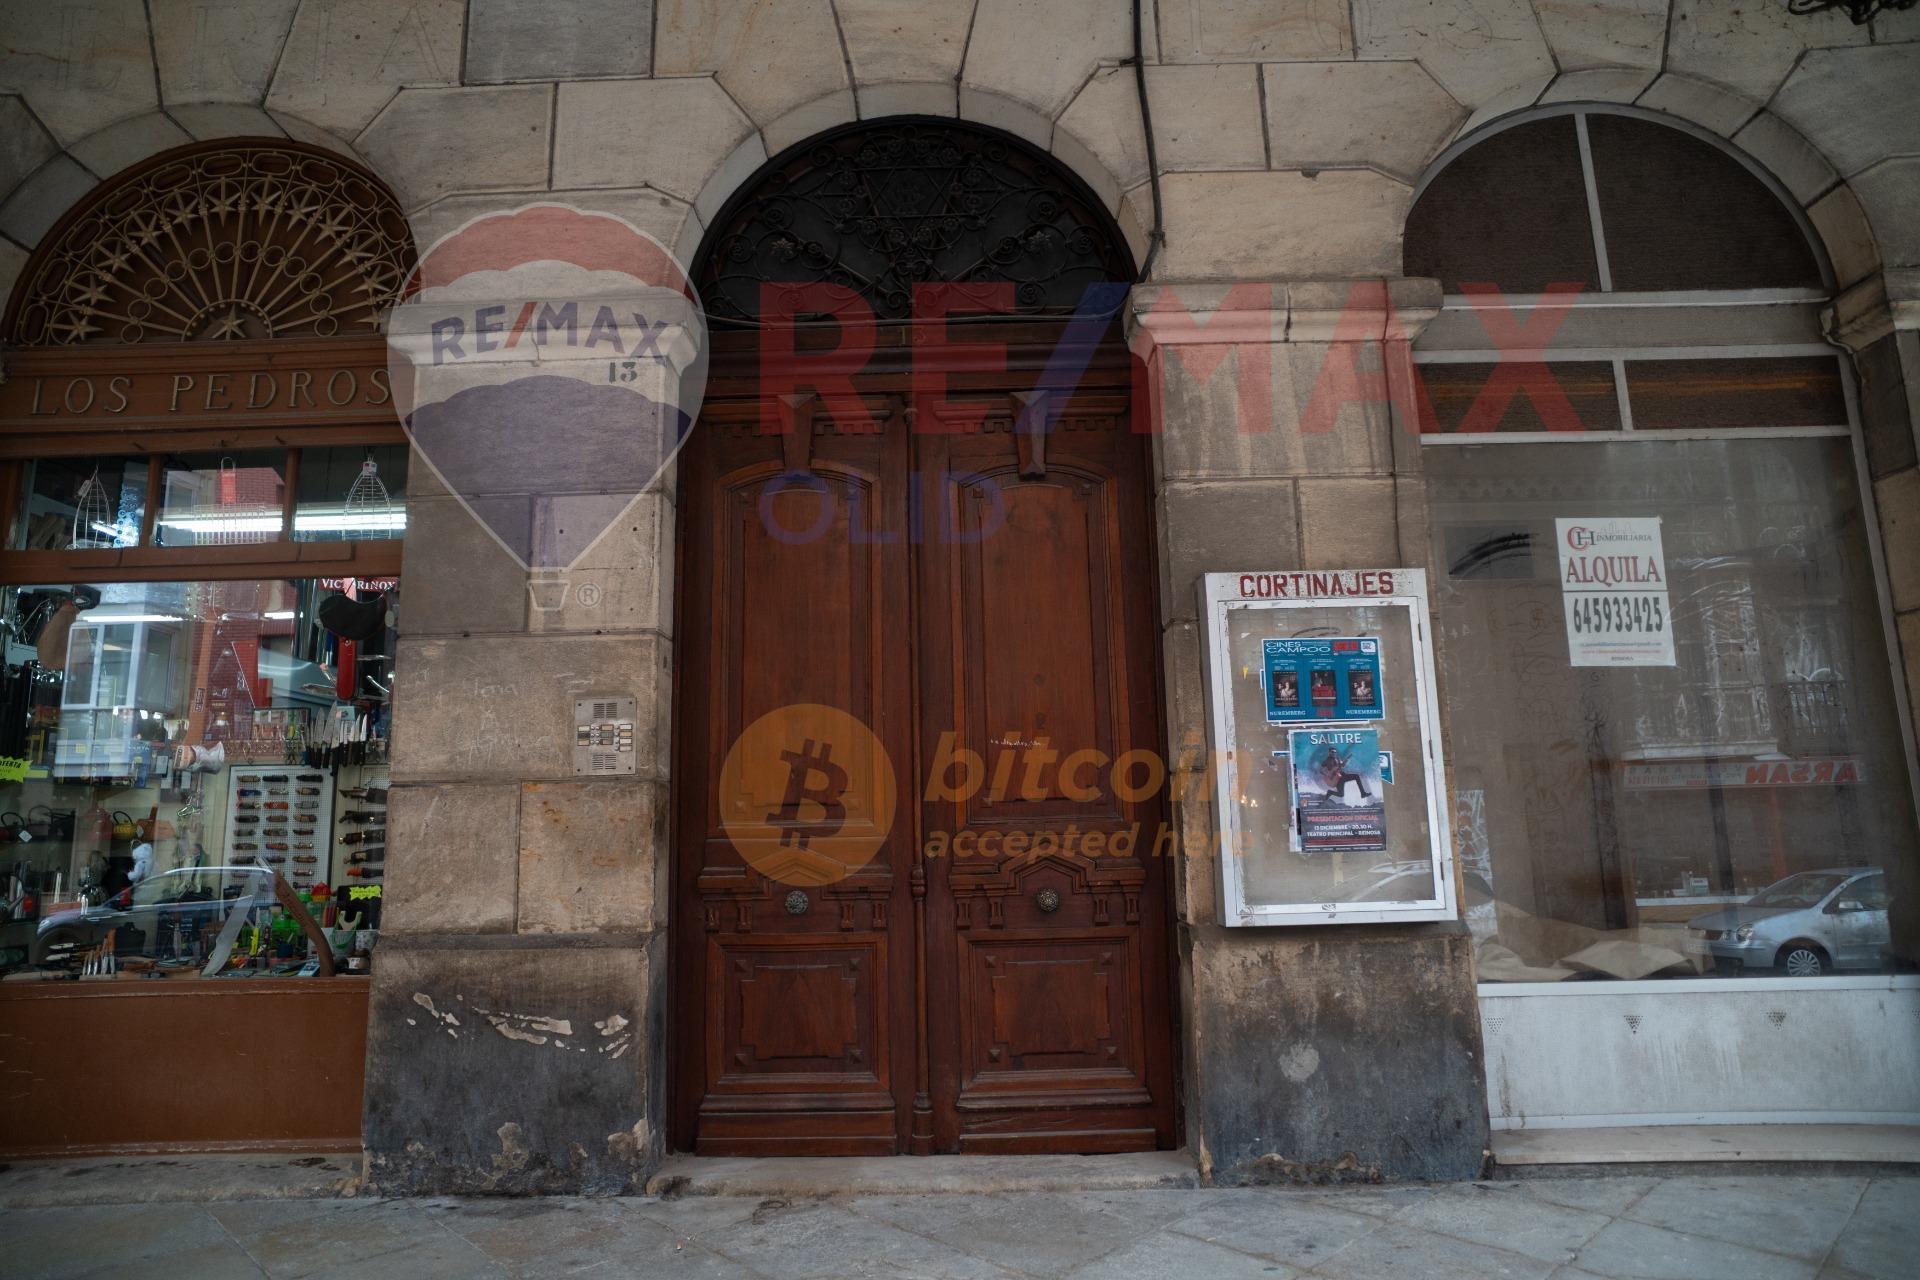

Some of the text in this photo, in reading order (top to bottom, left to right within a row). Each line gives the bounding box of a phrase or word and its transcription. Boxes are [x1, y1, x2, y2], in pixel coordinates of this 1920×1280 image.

[608, 361, 639, 383] 13
[30, 368, 391, 415] LOS PEDROS
[1597, 534, 1652, 542] INMOBILIARIA
[1566, 556, 1662, 587] ALQUILA
[321, 578, 396, 591] VICRINOX
[1239, 571, 1394, 598] CORTINAJES
[1573, 596, 1663, 633] 645933425
[1310, 733, 1362, 745] SALITRE
